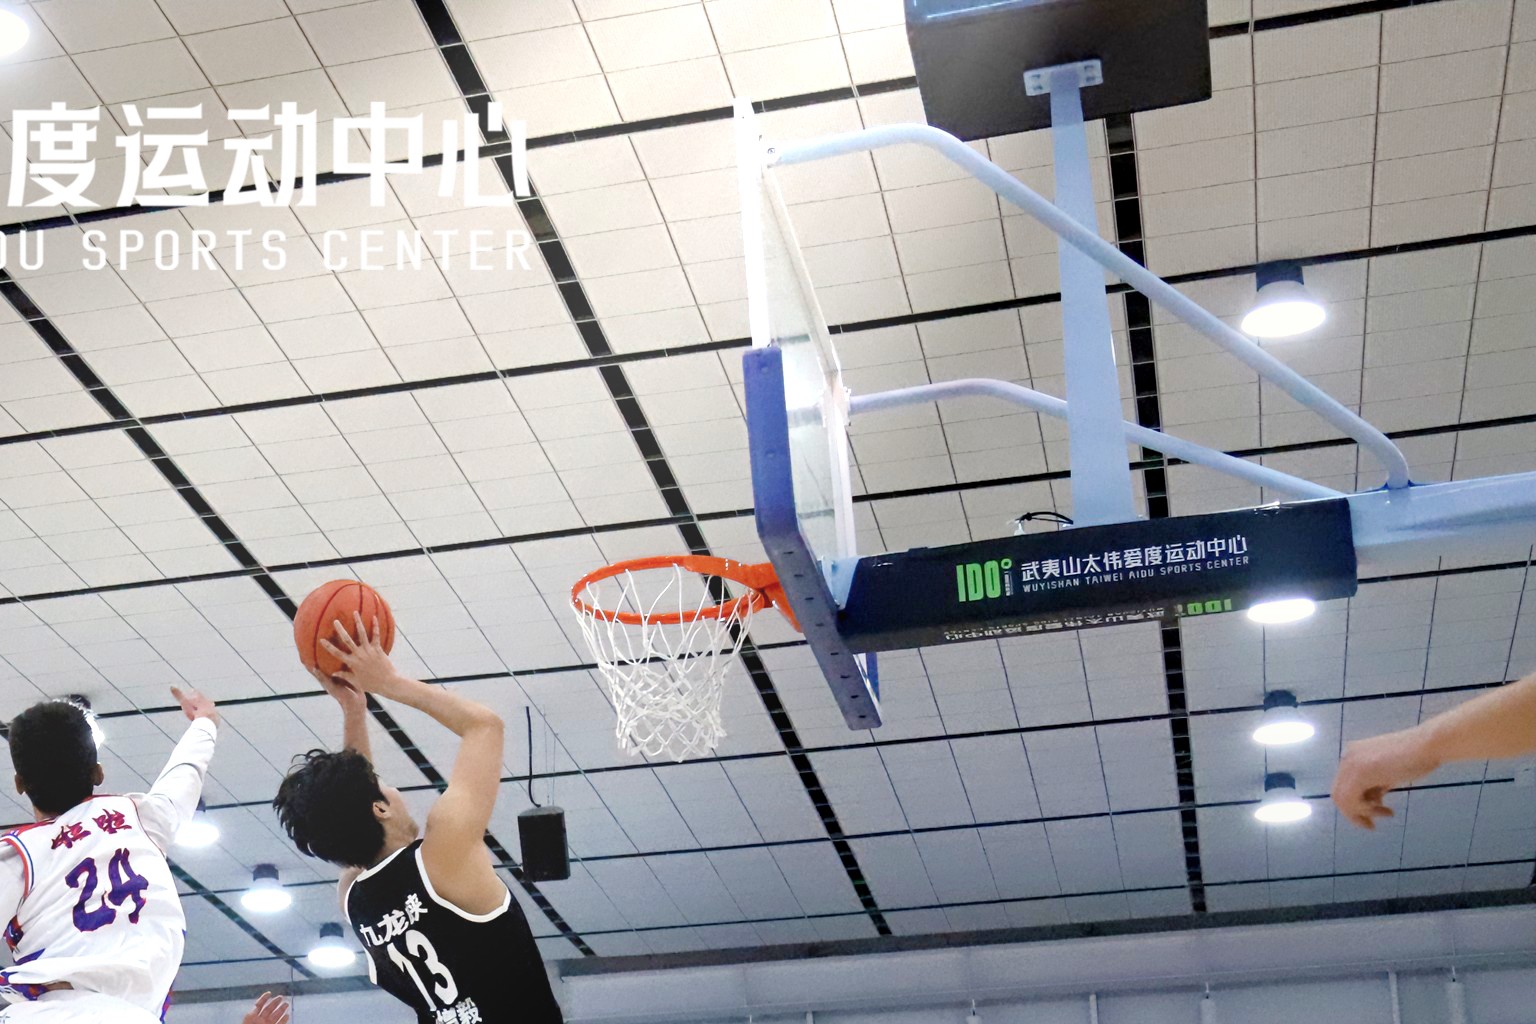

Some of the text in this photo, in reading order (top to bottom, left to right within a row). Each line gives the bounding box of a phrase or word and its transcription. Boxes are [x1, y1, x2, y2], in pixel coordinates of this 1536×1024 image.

[1021, 534, 1248, 582] 武夷山太伟爱度运动中心
[1023, 578, 1080, 593] WUYISHAN
[1085, 572, 1123, 585] TAIWEI
[1128, 568, 1154, 580] AIDU
[1159, 562, 1202, 576] SPORTS
[1206, 555, 1249, 570] CENTER
[65, 848, 149, 932] 24
[386, 929, 459, 1012] 13
